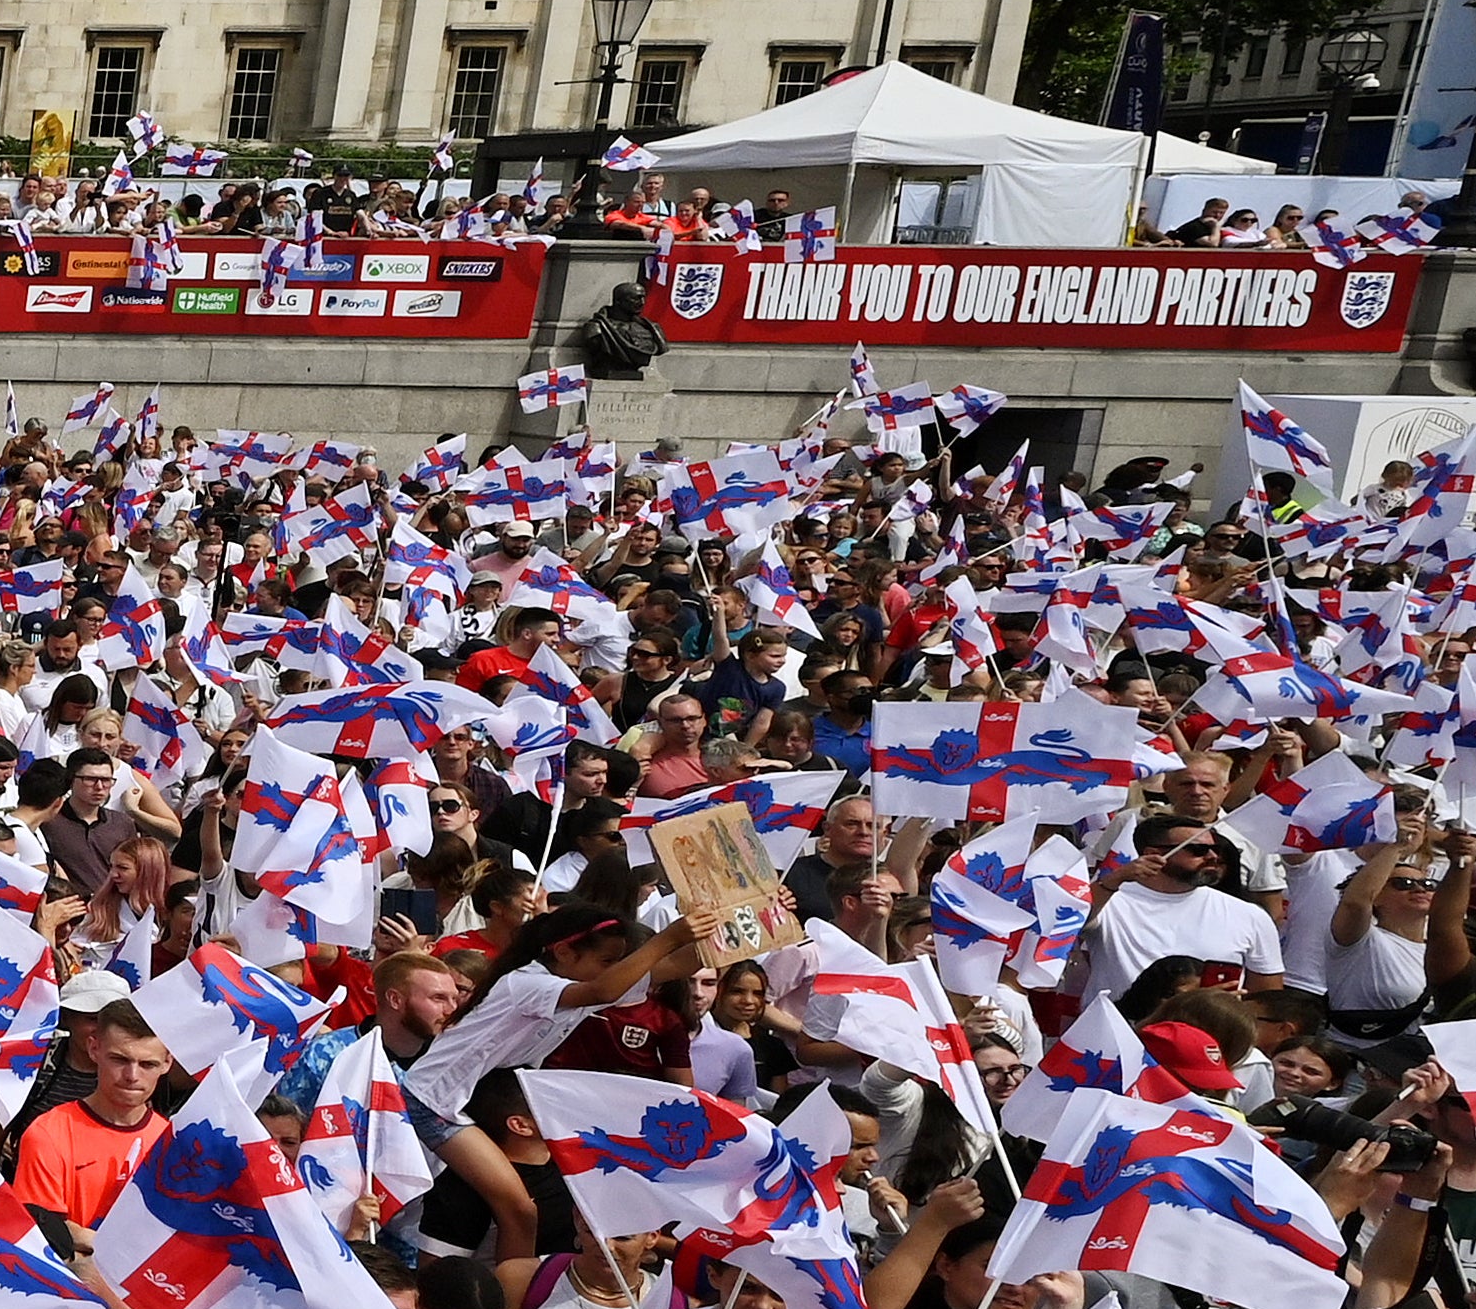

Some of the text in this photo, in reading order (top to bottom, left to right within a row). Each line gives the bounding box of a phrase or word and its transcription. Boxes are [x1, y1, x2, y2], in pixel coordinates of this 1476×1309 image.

[72, 259, 122, 270] Continental
[386, 263, 423, 274] XBOX
[445, 263, 493, 275] SNICKERS
[116, 294, 165, 306] Nationwide
[197, 291, 235, 303] Nuffield
[277, 294, 298, 307] LG
[340, 297, 380, 309] PayPal
[743, 262, 1318, 328] THANK YOU TO OUR ENGLAND PARTNERS
[196, 300, 227, 311] Health
